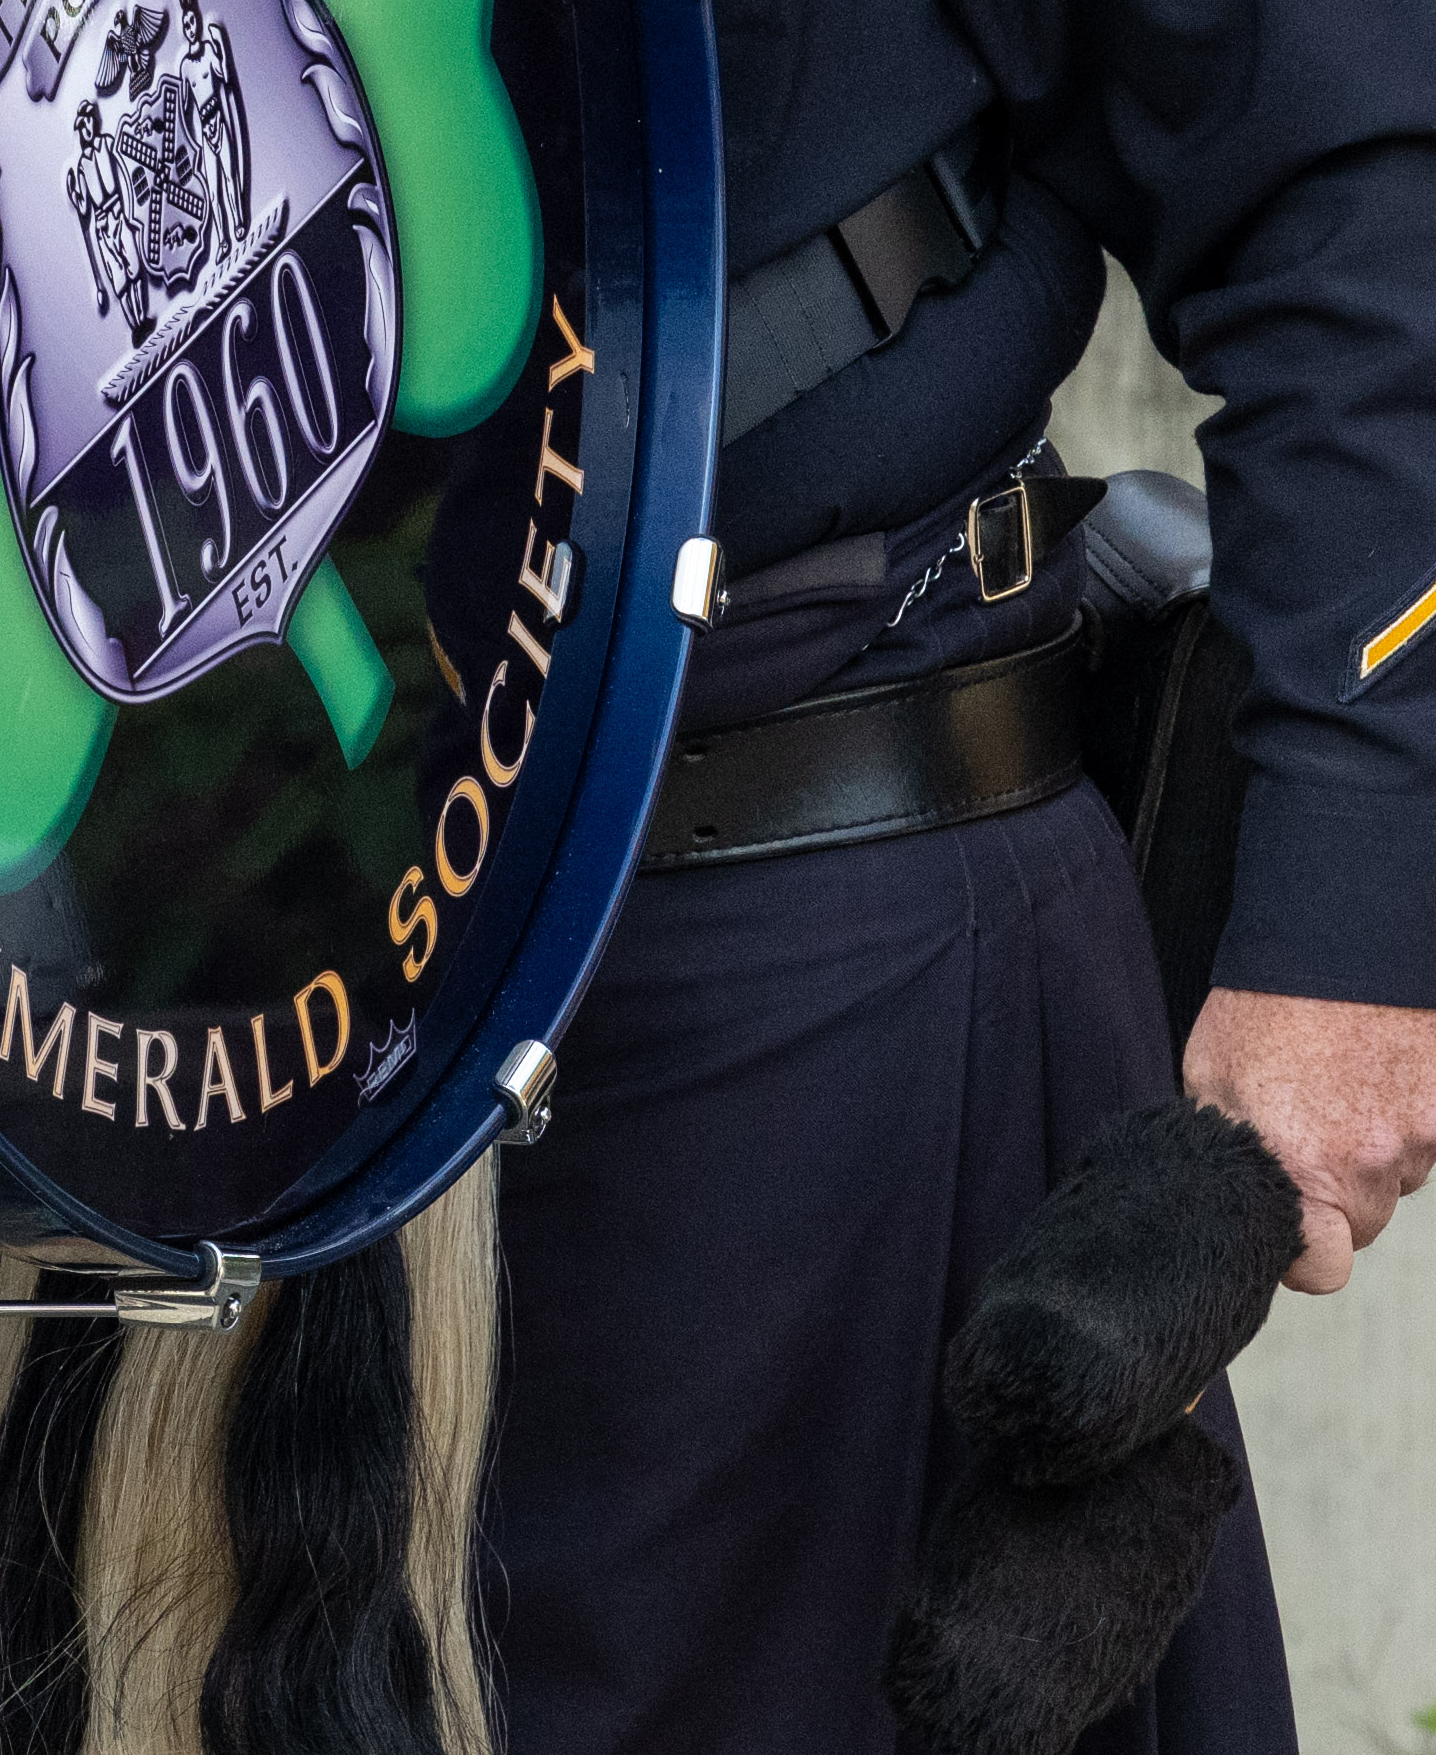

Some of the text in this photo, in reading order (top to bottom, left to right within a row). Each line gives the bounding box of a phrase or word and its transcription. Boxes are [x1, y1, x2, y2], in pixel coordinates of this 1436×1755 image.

[109, 248, 340, 642] 1960
[231, 535, 299, 629] EST.
[387, 293, 596, 983] SOCIETY
